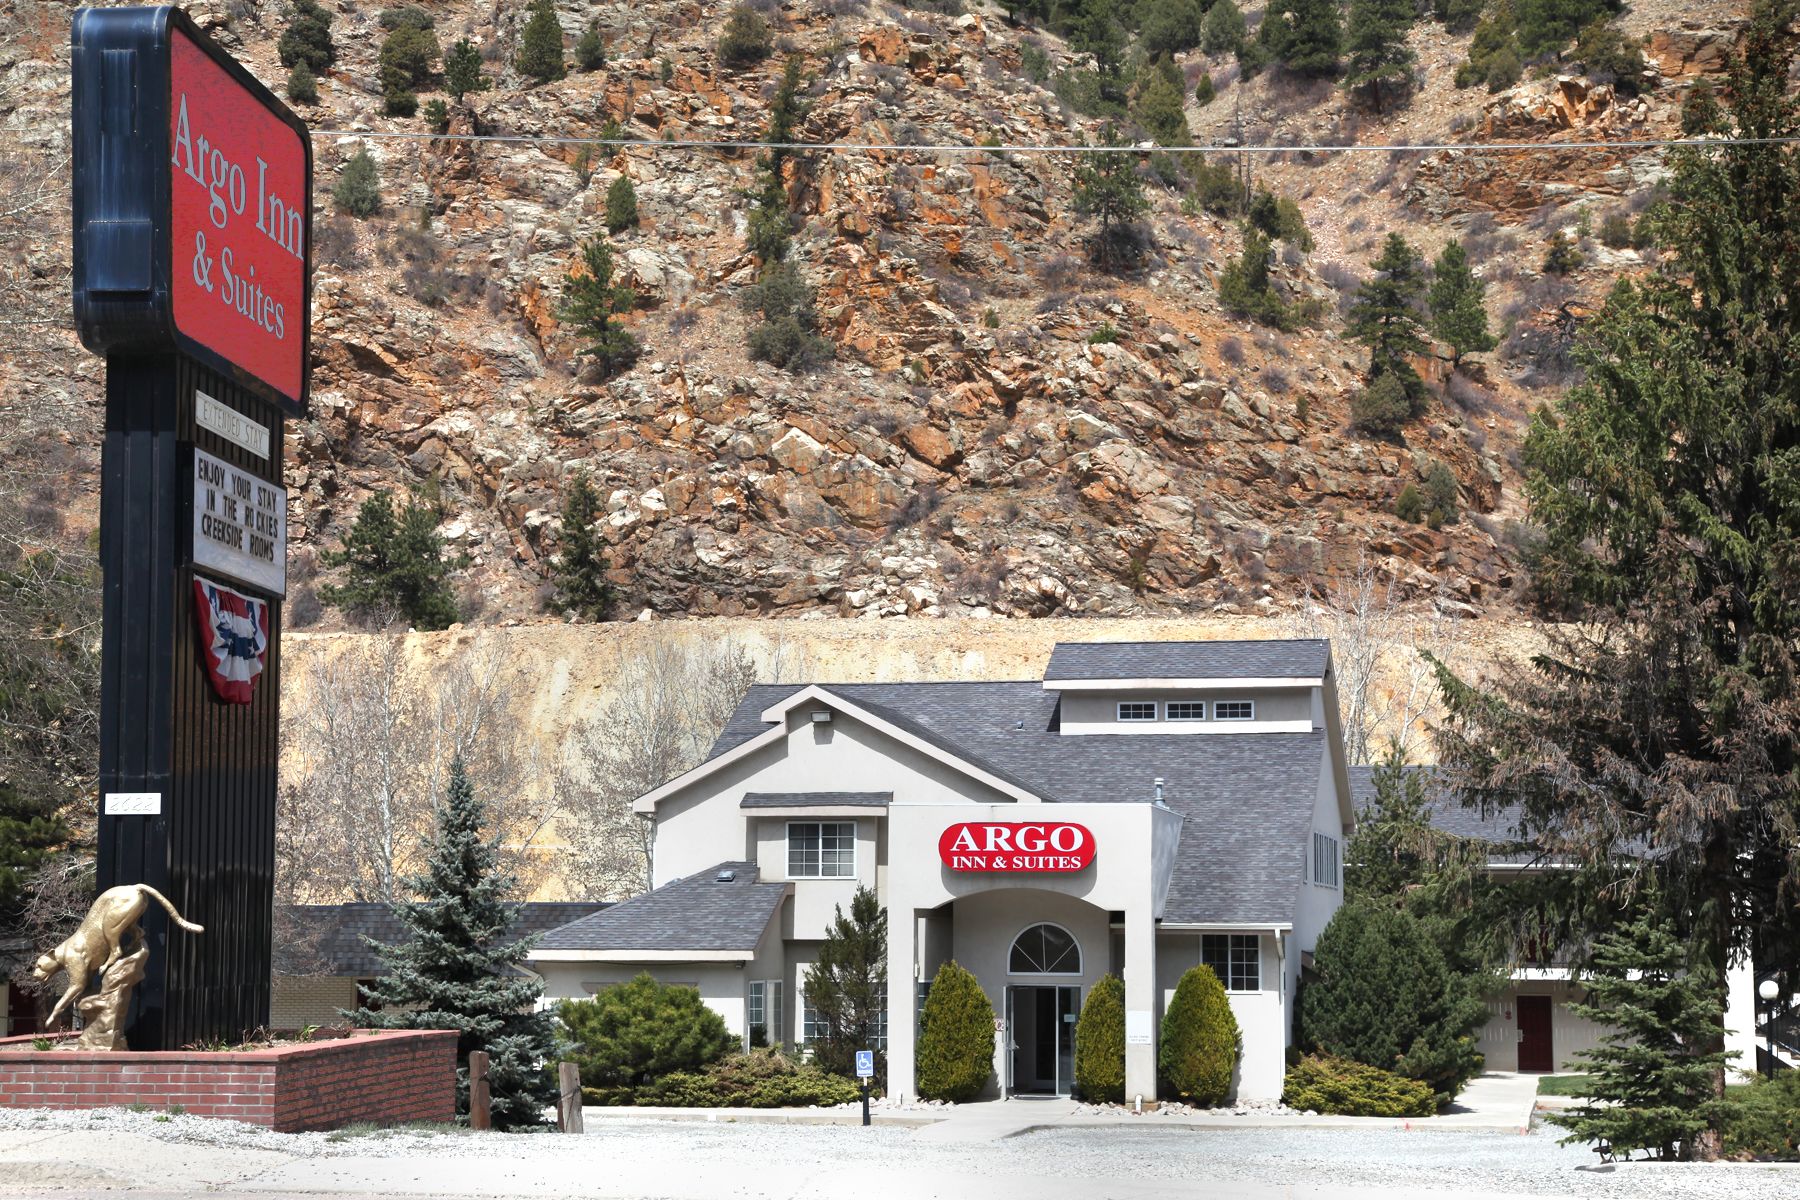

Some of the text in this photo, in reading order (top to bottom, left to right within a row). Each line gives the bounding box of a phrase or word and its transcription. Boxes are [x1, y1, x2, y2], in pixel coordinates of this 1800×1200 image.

[172, 92, 304, 262] Argo Inn
[192, 230, 285, 340] & Suites
[203, 400, 263, 449] EXTENDED STAY
[198, 457, 277, 513] ENJOY YOUR STAY
[206, 488, 216, 512] IN
[223, 494, 237, 522] THE
[202, 513, 274, 562] CREEKSIDE ROOMS
[950, 826, 1084, 852] ARGO
[952, 855, 1082, 869] INN & SUITES
